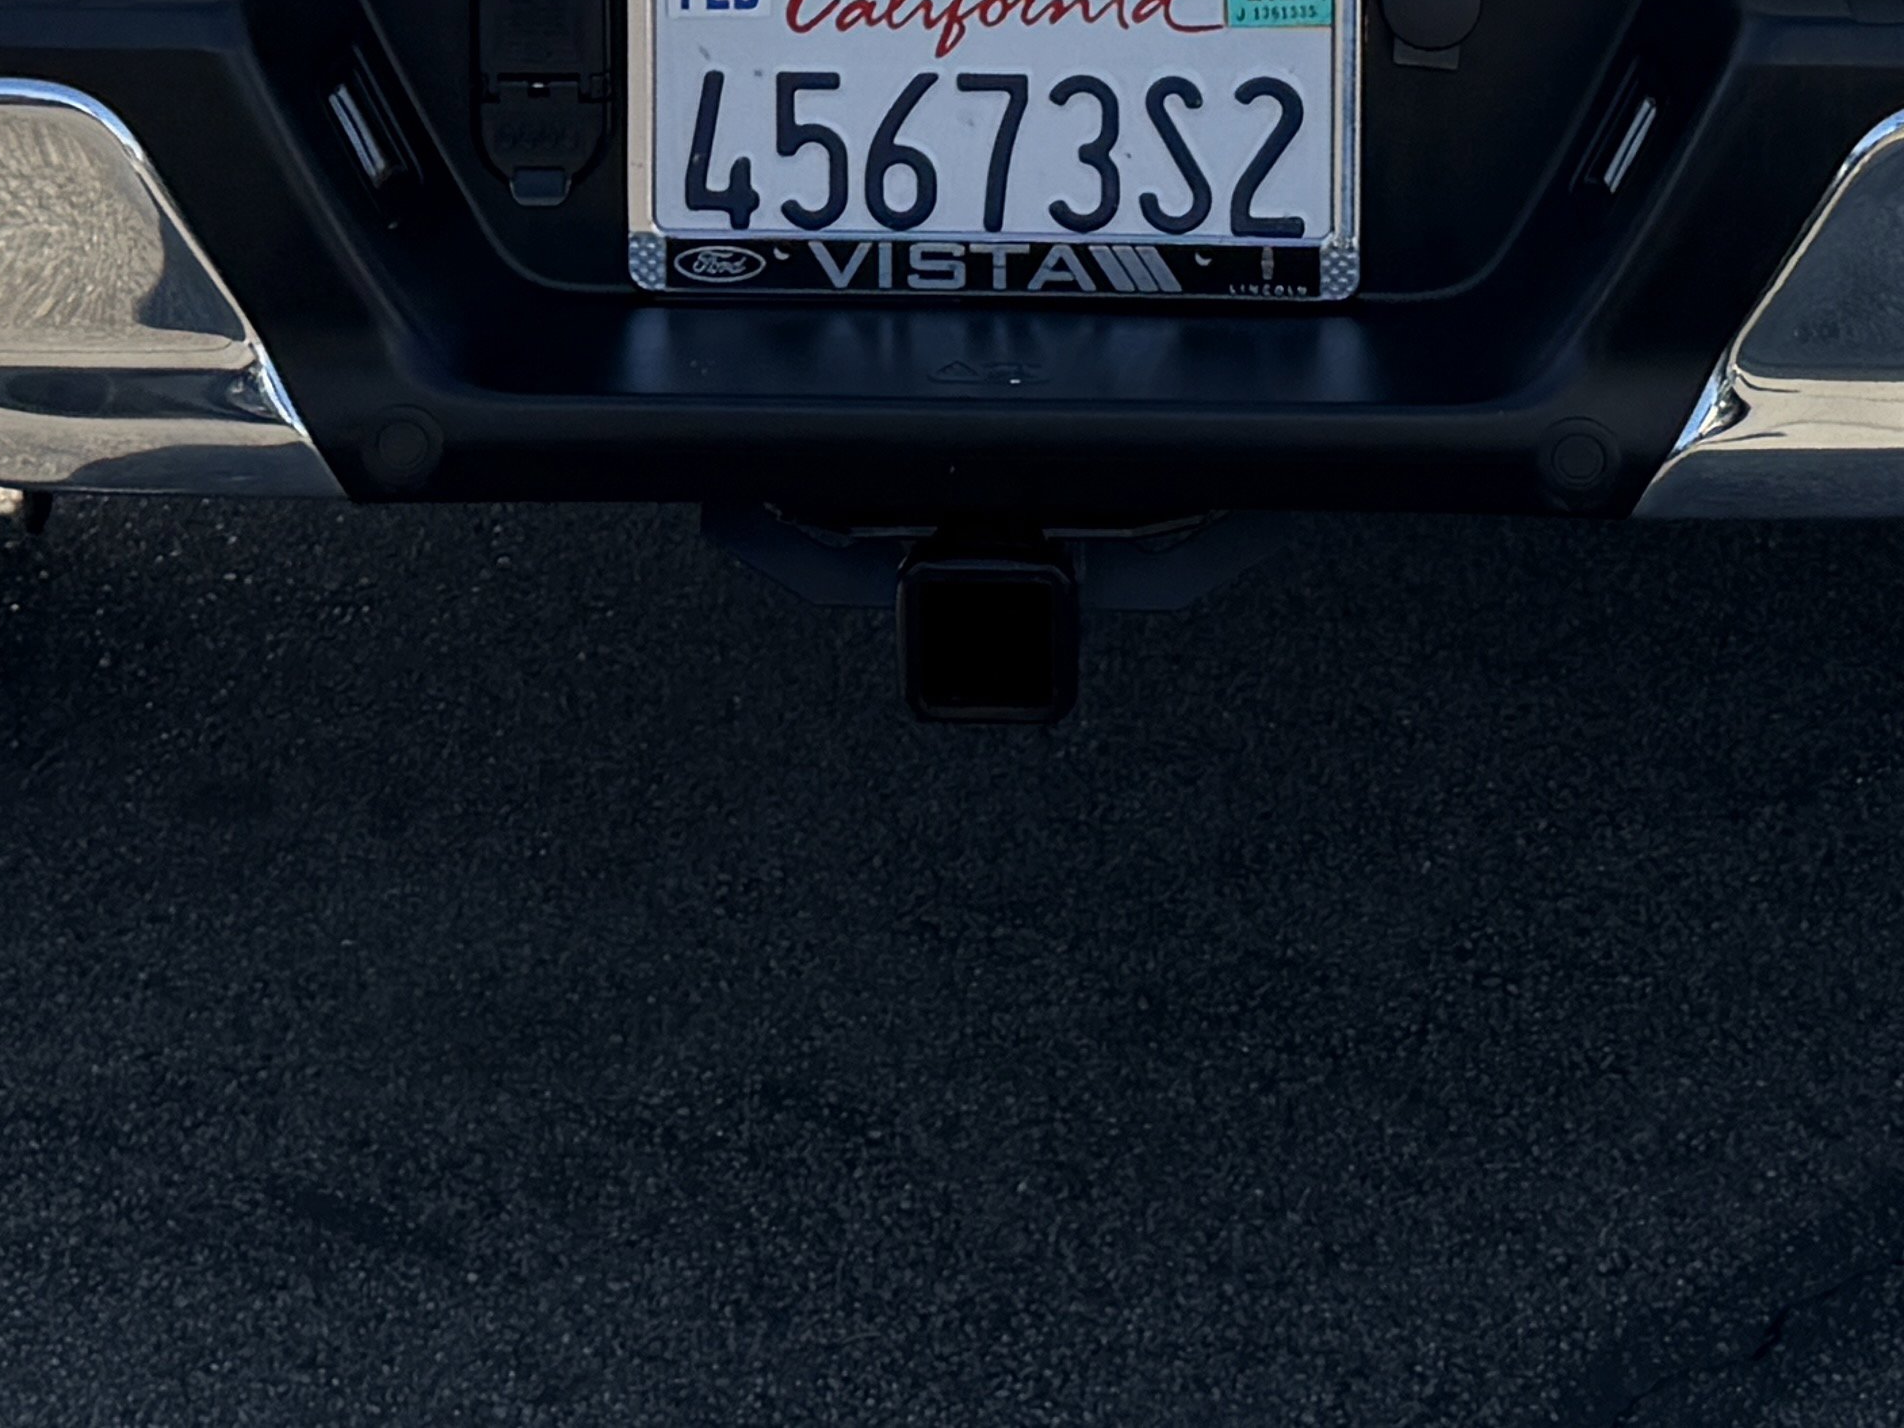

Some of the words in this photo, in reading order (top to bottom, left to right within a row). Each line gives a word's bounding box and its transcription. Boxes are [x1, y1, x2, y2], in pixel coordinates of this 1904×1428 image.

[684, 69, 1306, 239] 45673S2
[692, 251, 747, 275] Ford
[808, 240, 1097, 291] VISTA
